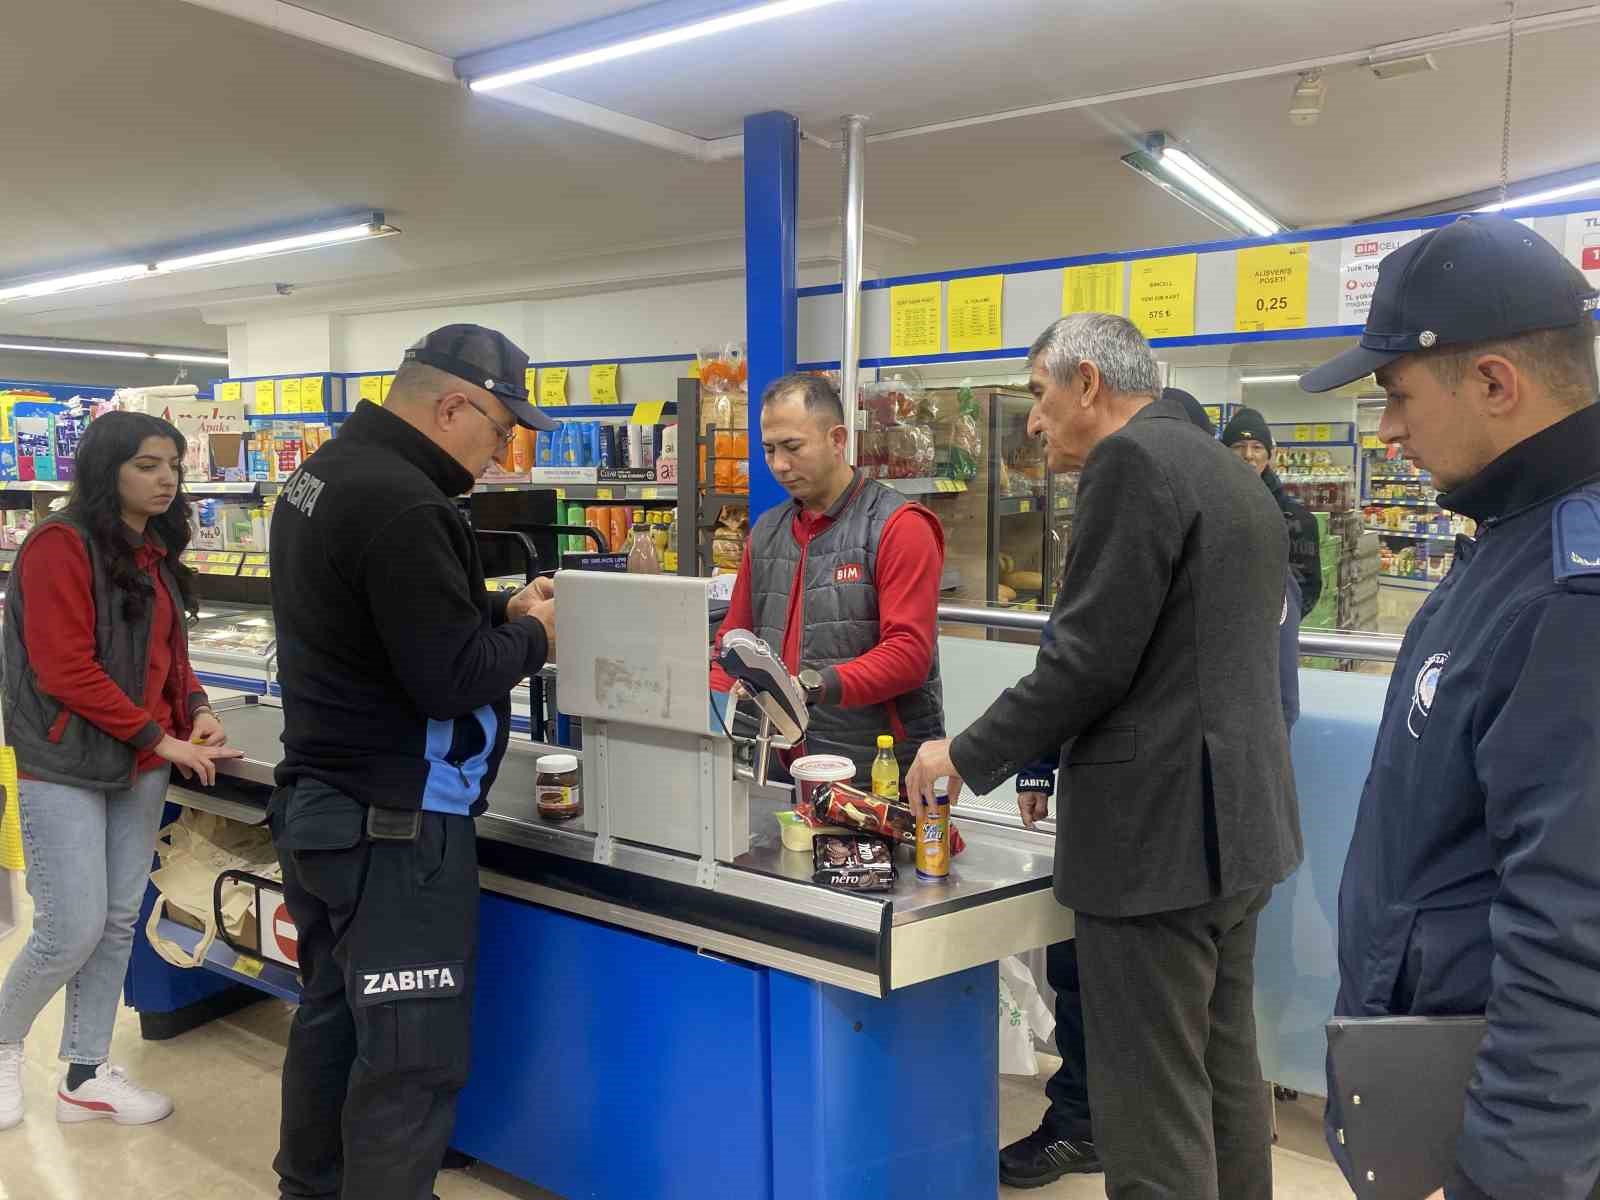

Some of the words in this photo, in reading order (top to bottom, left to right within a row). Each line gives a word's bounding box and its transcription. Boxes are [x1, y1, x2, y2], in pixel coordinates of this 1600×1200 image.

[1256, 296, 1288, 312] 0,25
[837, 567, 858, 580] BIM
[1019, 778, 1050, 788] ZABITA
[363, 967, 455, 995] ZABITA
